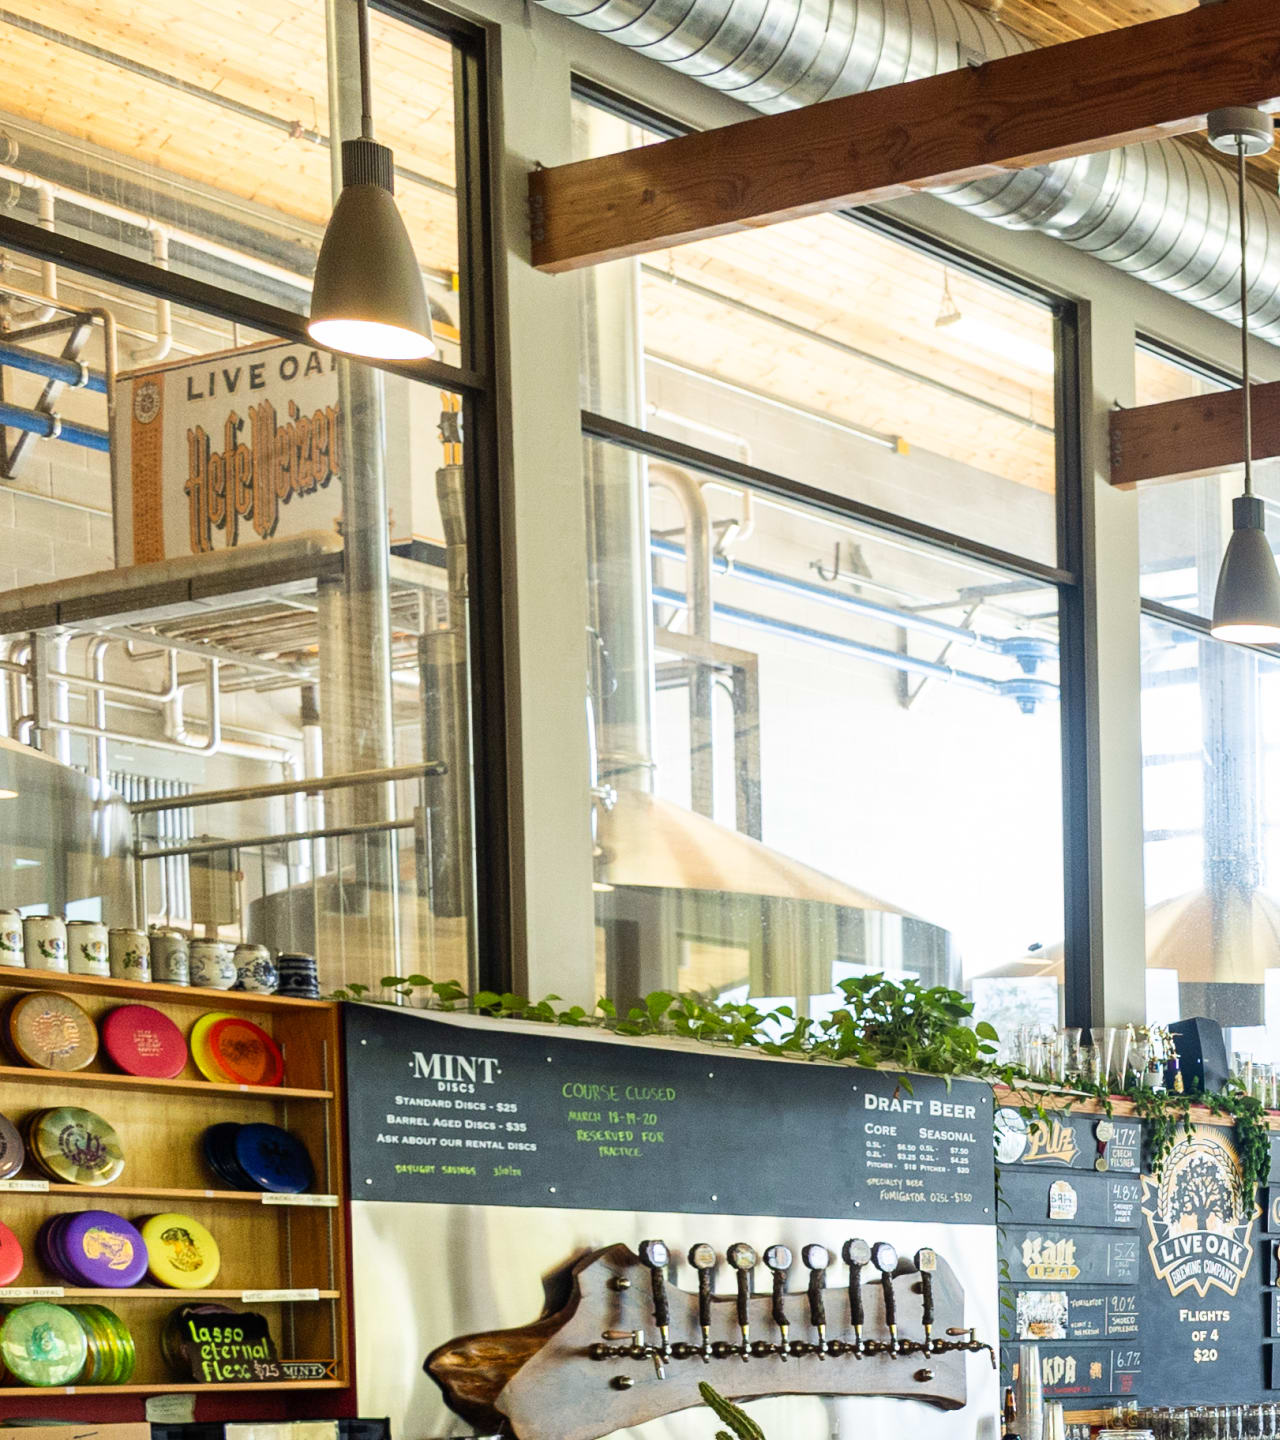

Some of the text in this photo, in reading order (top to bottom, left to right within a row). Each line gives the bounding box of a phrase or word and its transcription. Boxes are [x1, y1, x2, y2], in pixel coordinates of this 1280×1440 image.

[187, 363, 266, 401] LIVE
[412, 1051, 499, 1084] MINT
[438, 1082, 476, 1094] DISCS
[562, 1082, 676, 1102] COURSE CLOSED
[395, 1095, 518, 1113] STANDARD DISCS $25
[864, 1093, 976, 1119] DRAFT BEER
[386, 1114, 527, 1133] BARREL AGED DISCS $35
[567, 1110, 601, 1122] MARCH
[376, 1133, 537, 1152] ASK ABOUT OUR RENTAL DISCS
[576, 1129, 665, 1143] RESERVED FOR
[864, 1123, 977, 1143] CORE SEASONAL
[599, 1146, 643, 1157] PRACTICE
[879, 1189, 926, 1202] FUMIGATOR
[1160, 1235, 1243, 1265] LIVE OAK
[1171, 1260, 1236, 1285] BREWING COMPANY
[1179, 1309, 1231, 1322] FLIGHTS
[188, 1320, 243, 1343] lasso
[1191, 1328, 1219, 1341] OF 4
[201, 1337, 270, 1361] eternal
[1193, 1347, 1218, 1364] $20
[1117, 1351, 1141, 1368] 6.7%
[254, 1360, 280, 1380] $25
[282, 1365, 319, 1376] MINT
[1042, 1355, 1077, 1385] KPA
